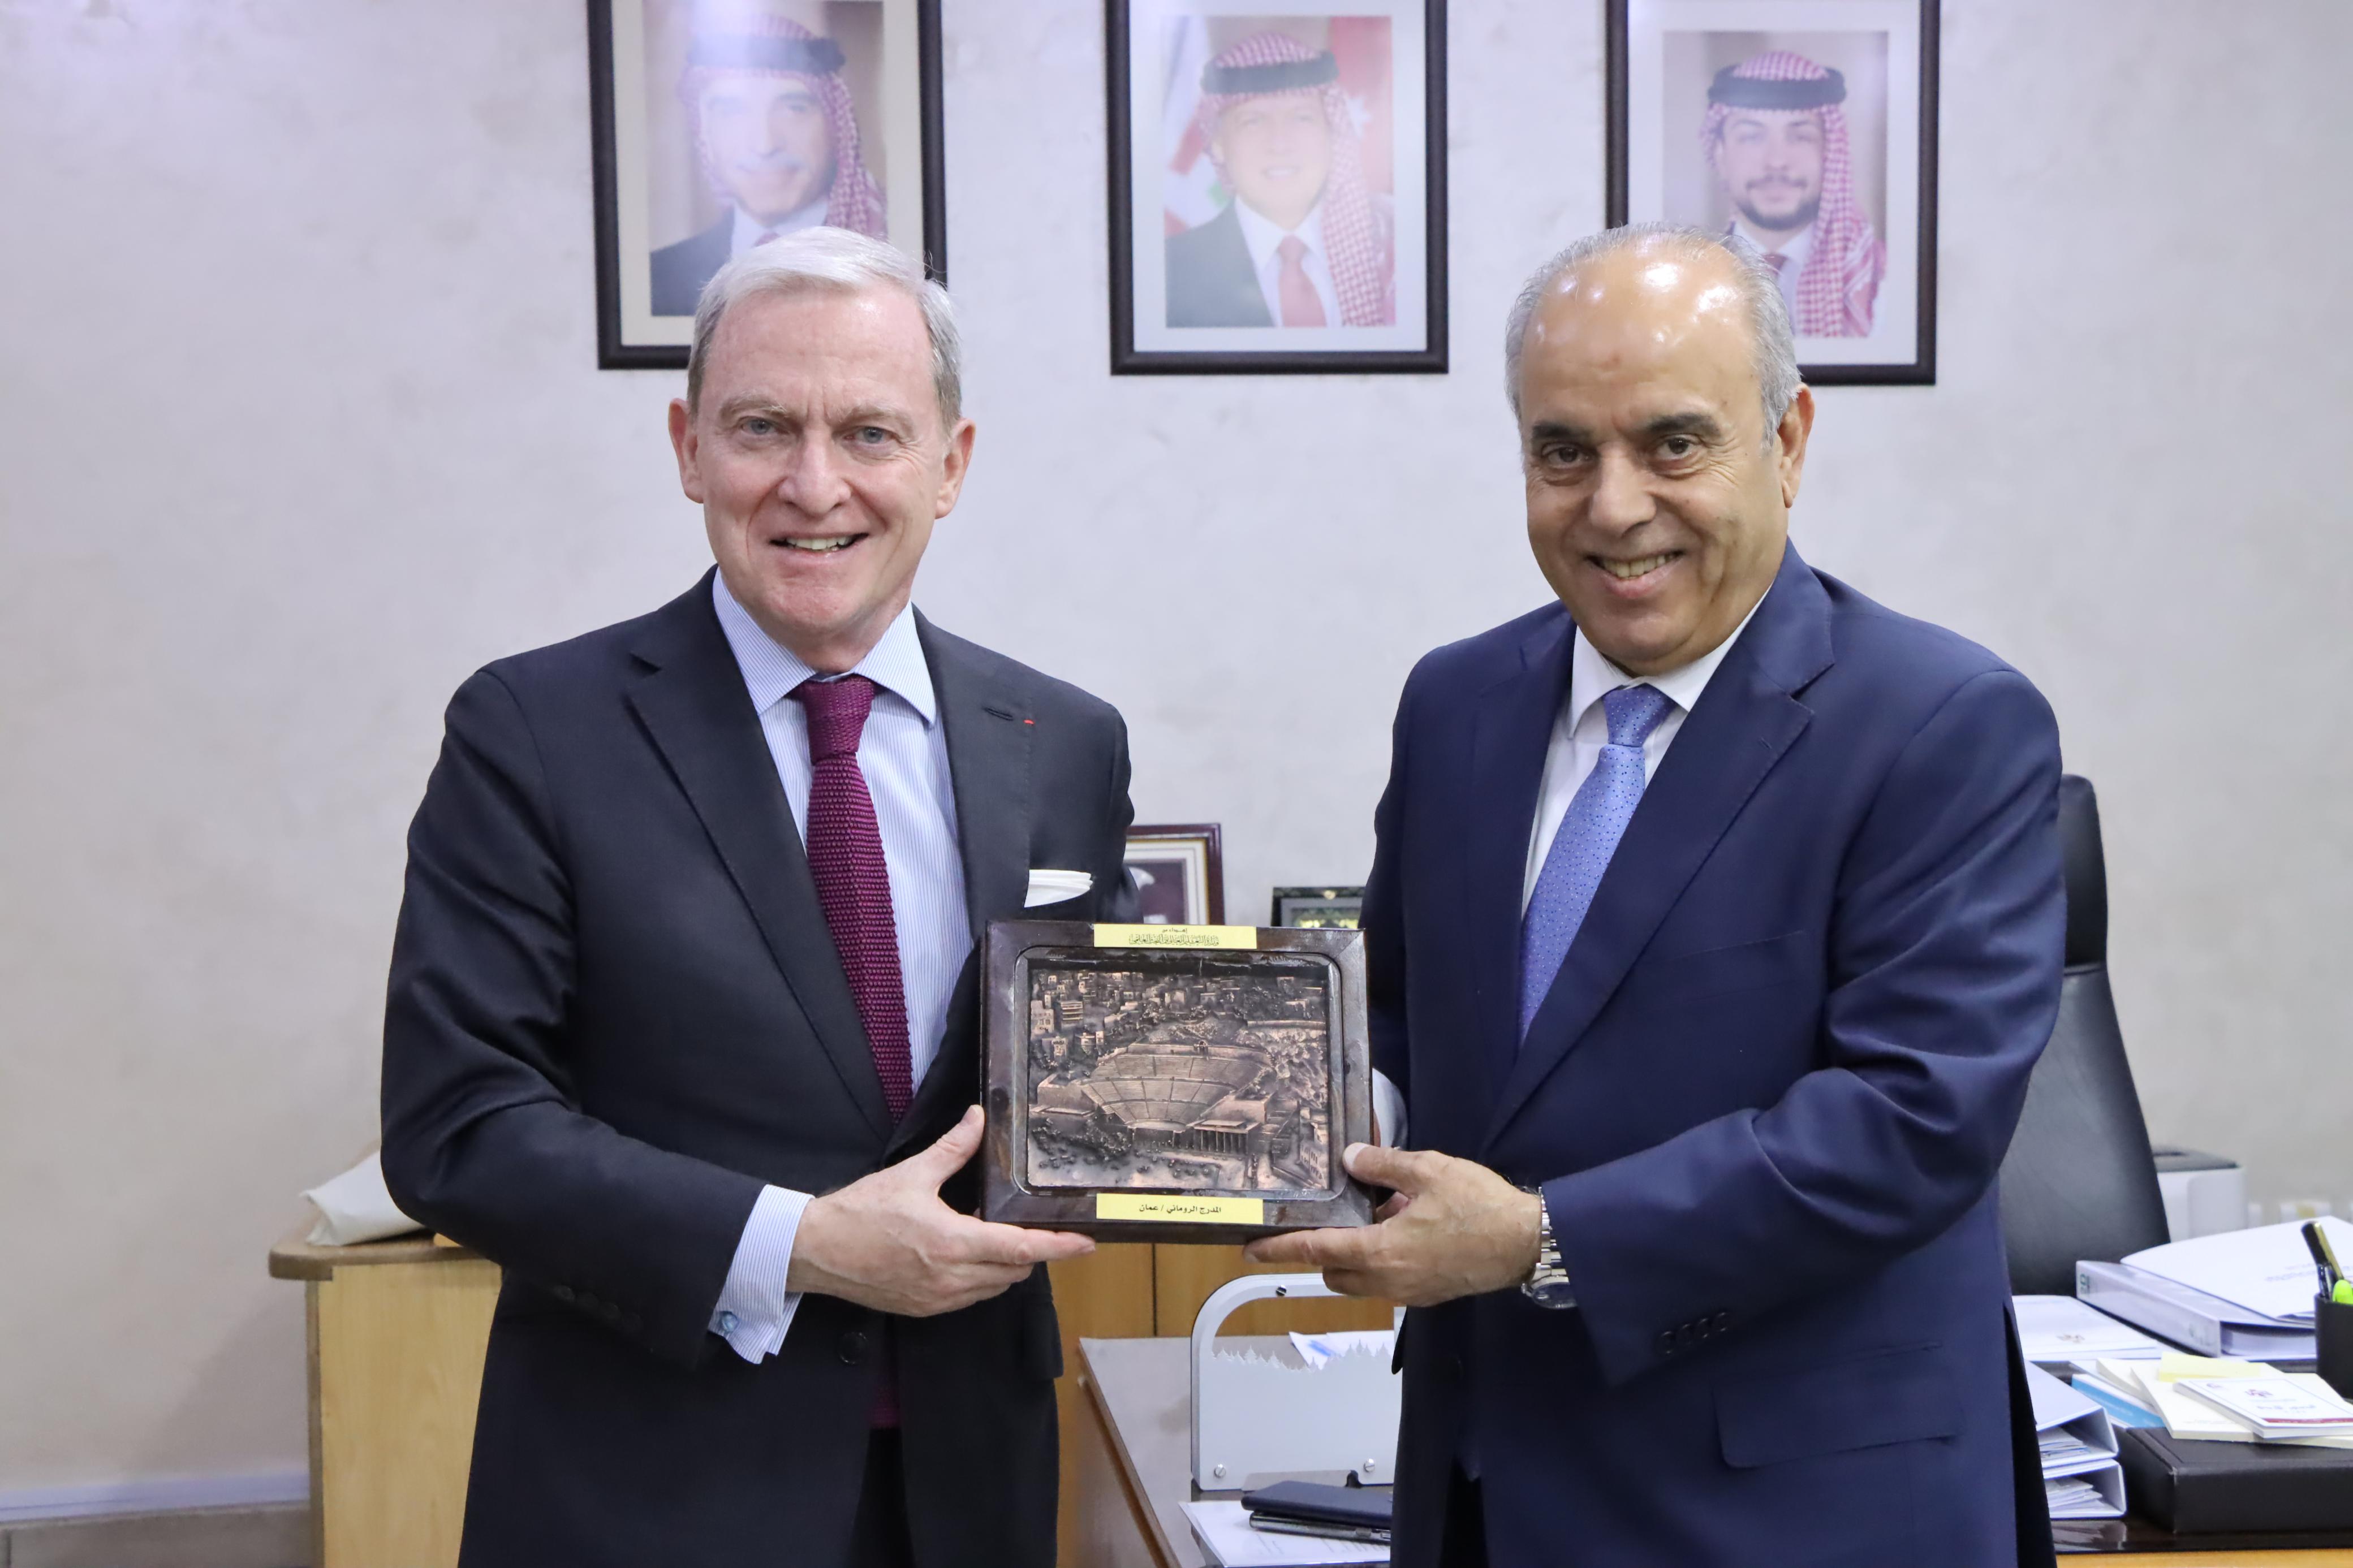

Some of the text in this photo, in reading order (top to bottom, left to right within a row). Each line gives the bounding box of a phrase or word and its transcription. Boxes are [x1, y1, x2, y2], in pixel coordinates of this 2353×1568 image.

[1128, 934, 1150, 945] العلمي
[1184, 935, 1205, 945] التعليم
[1204, 935, 1219, 946] وزارة
[1139, 1204, 1158, 1212] عمان
[1166, 1205, 1198, 1214] الروماني
[1199, 1206, 1221, 1215] المدرج
